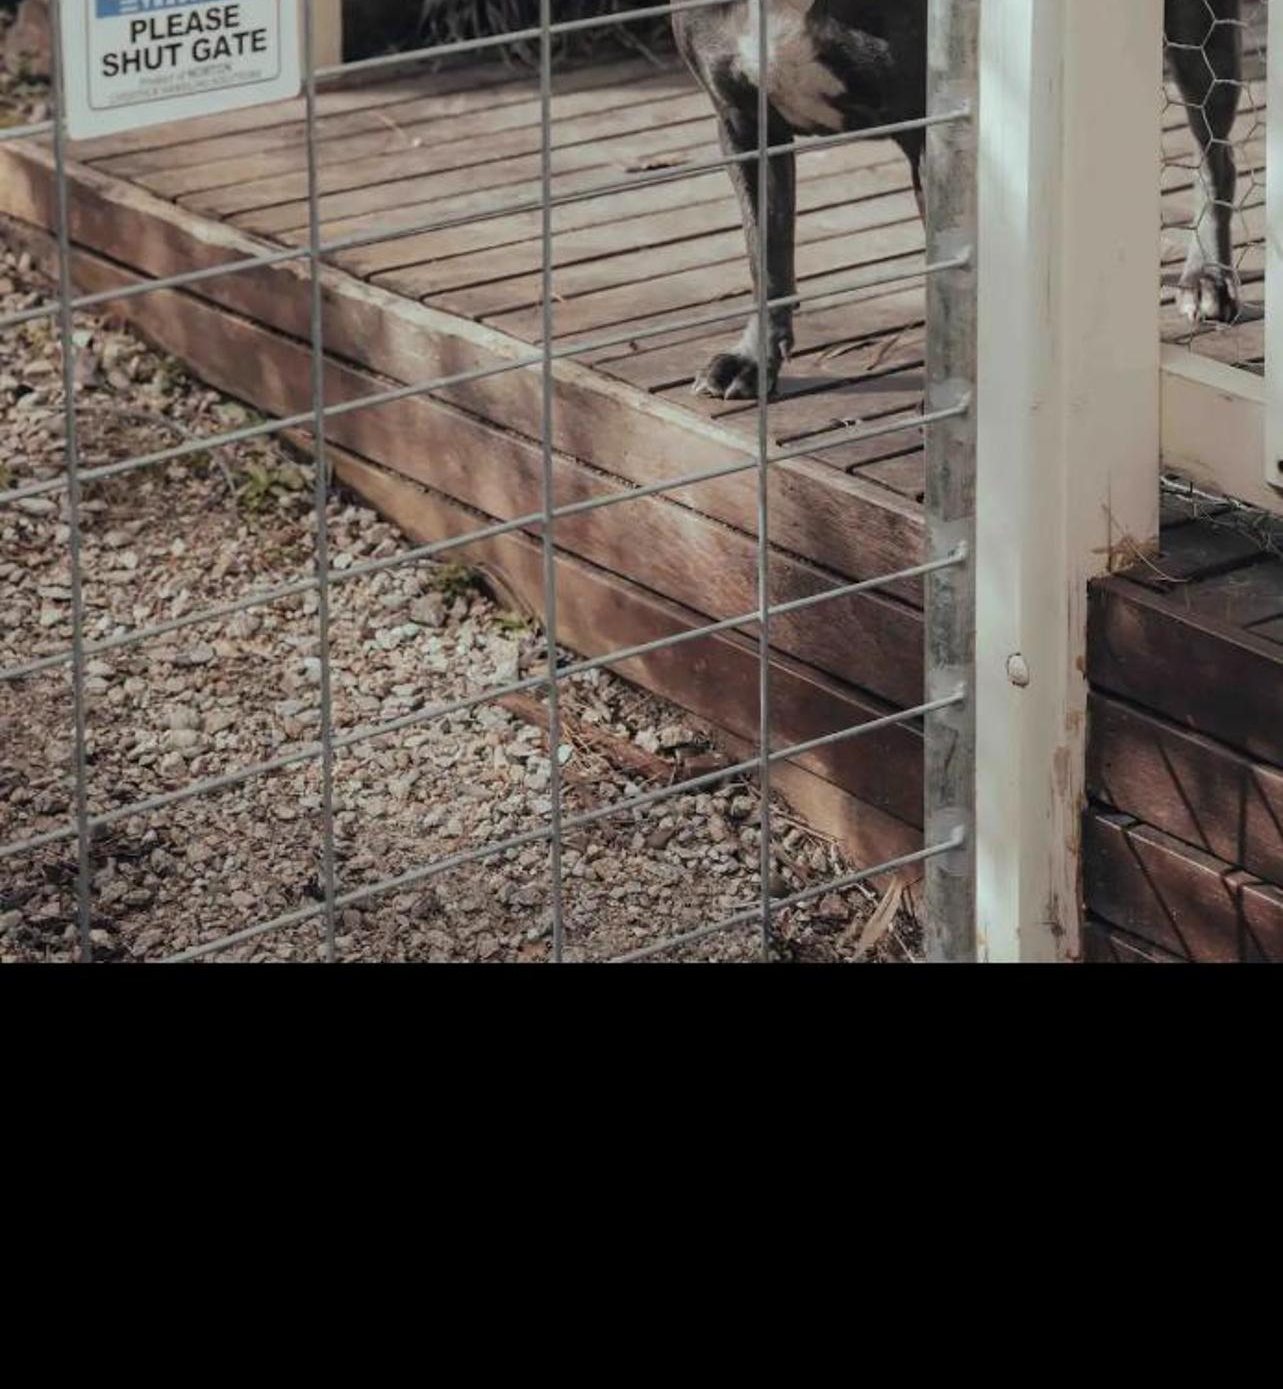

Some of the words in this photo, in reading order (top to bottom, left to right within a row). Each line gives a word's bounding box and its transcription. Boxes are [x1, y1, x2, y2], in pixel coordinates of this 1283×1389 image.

[130, 5, 240, 44] PLEASE
[102, 43, 182, 78] SHUT
[191, 28, 267, 63] GATE
